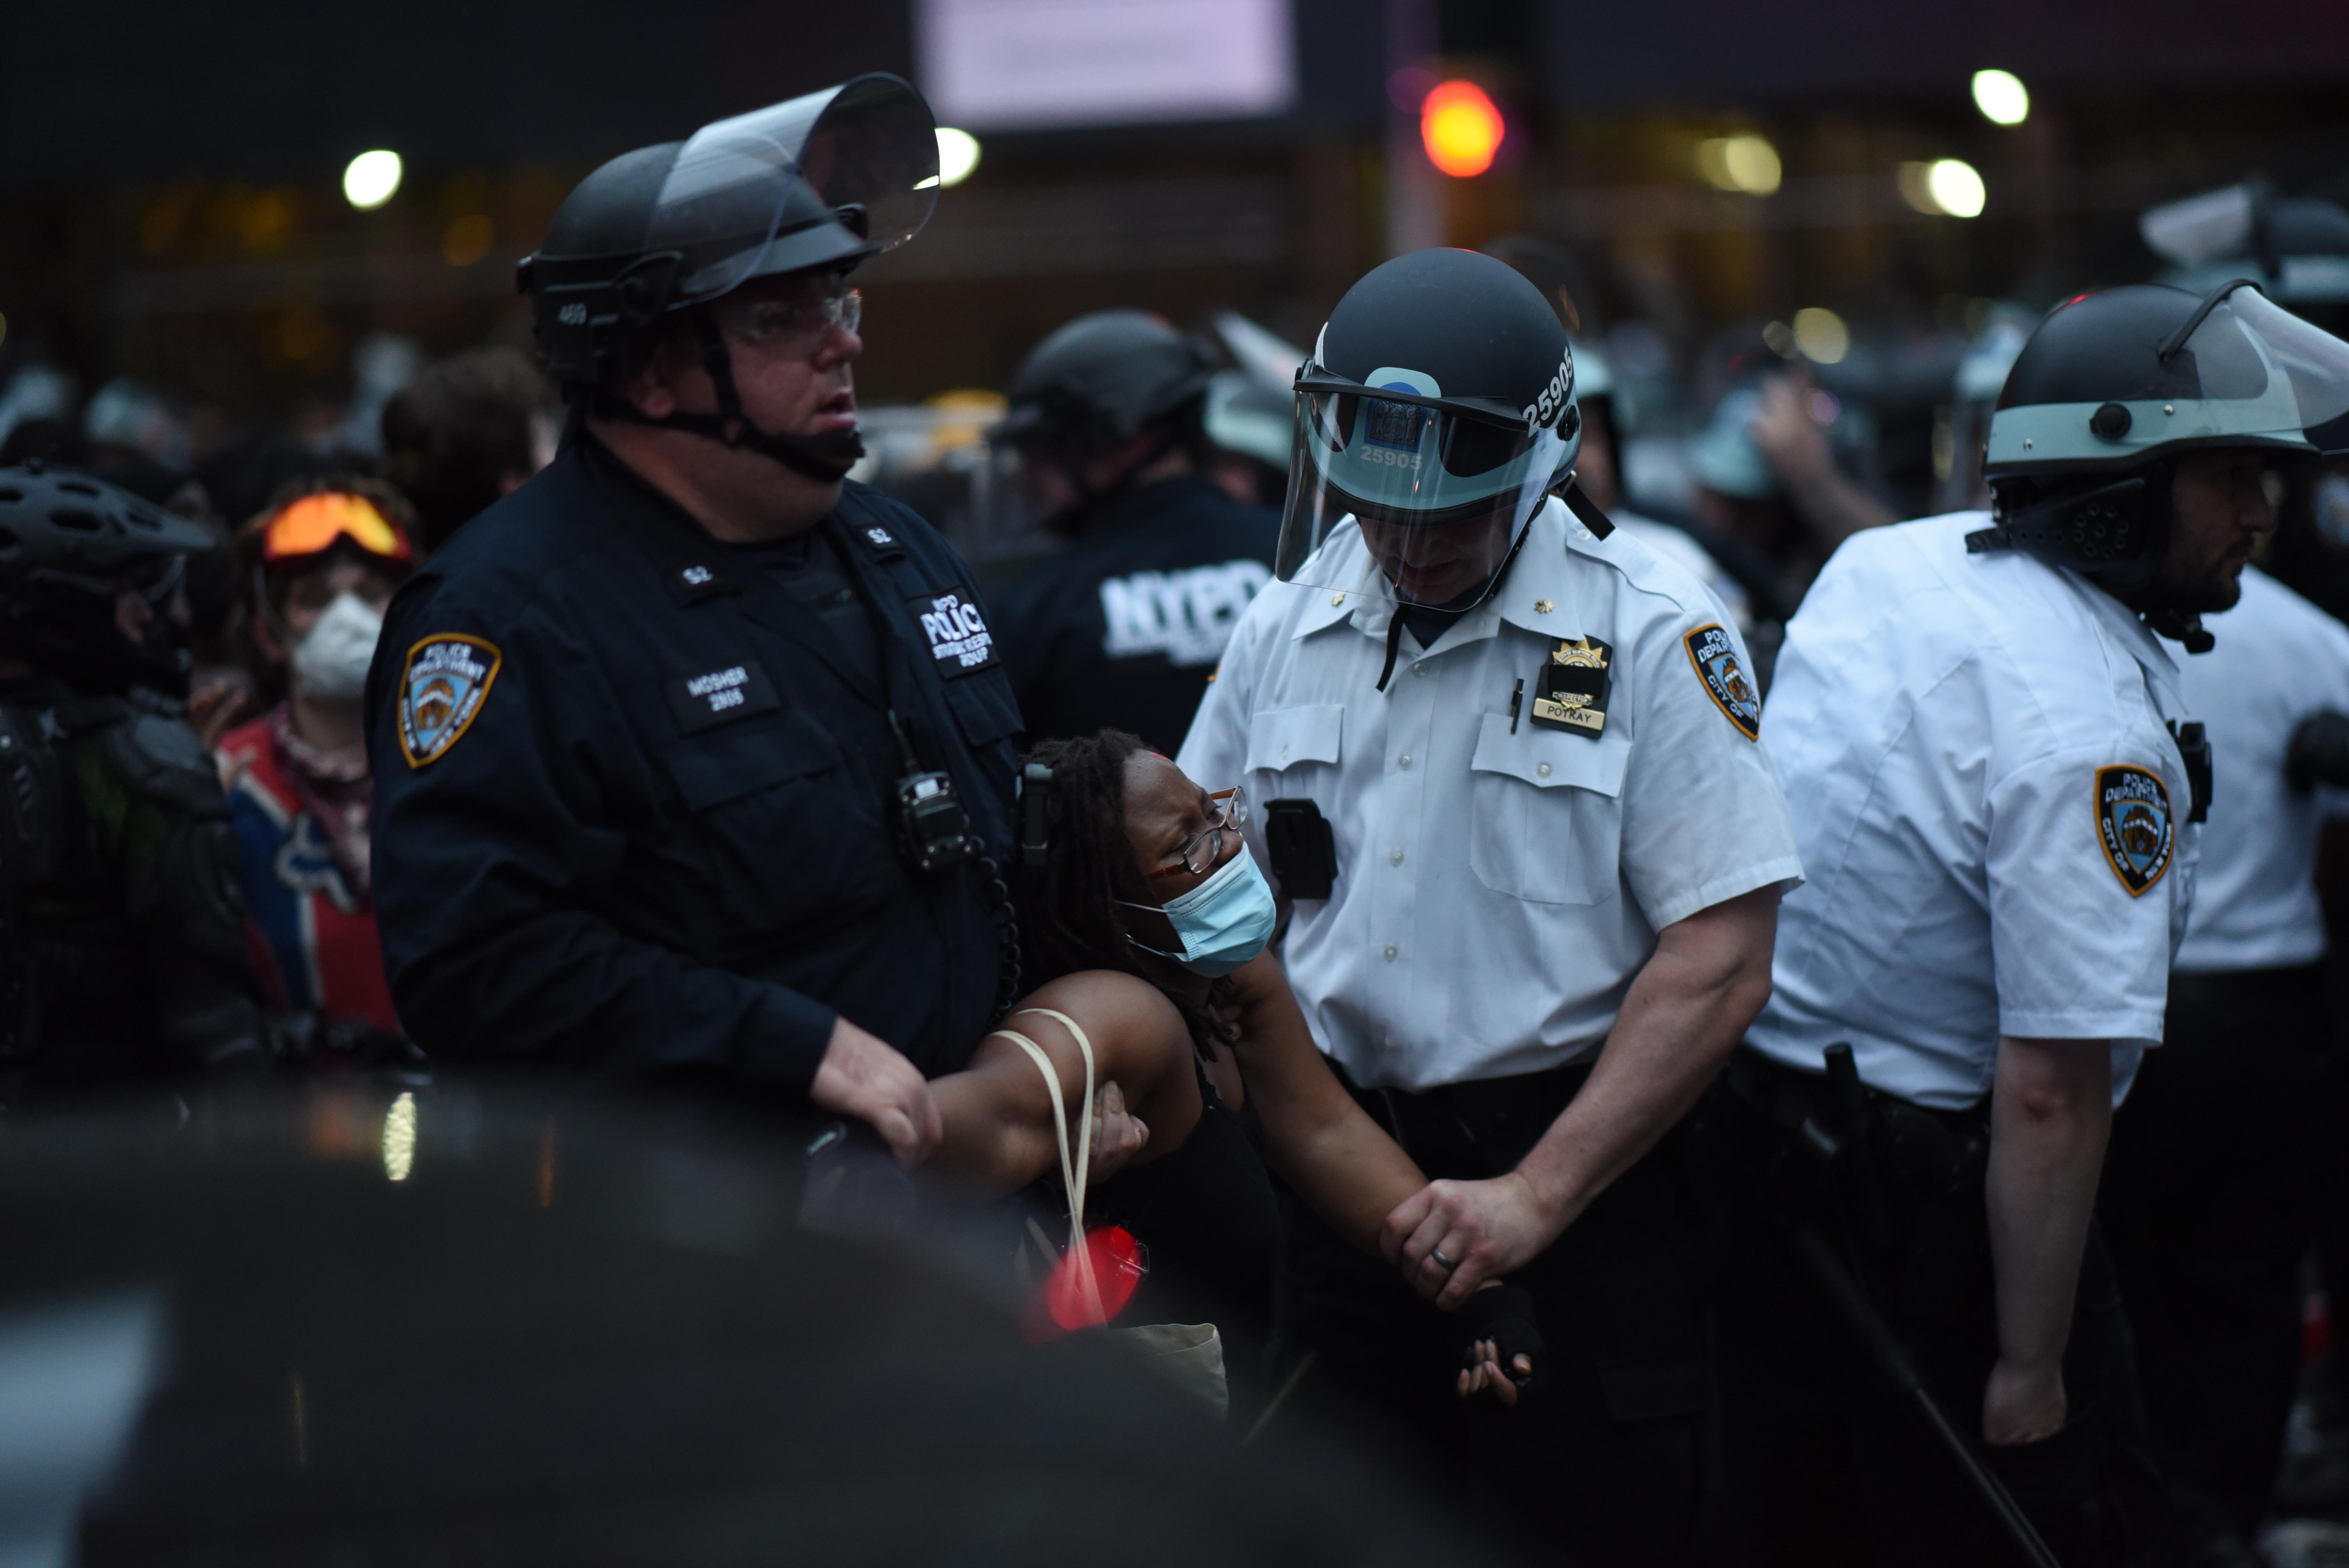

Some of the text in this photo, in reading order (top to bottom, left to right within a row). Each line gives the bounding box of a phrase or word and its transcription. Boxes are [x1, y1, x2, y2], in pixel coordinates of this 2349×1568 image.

[1523, 346, 1573, 437] 25905
[1361, 446, 1422, 469] 25905
[1557, 693, 1588, 703] INSPECTOR
[1708, 675, 1744, 718] CITY OF
[1547, 706, 1592, 723] POTRAY
